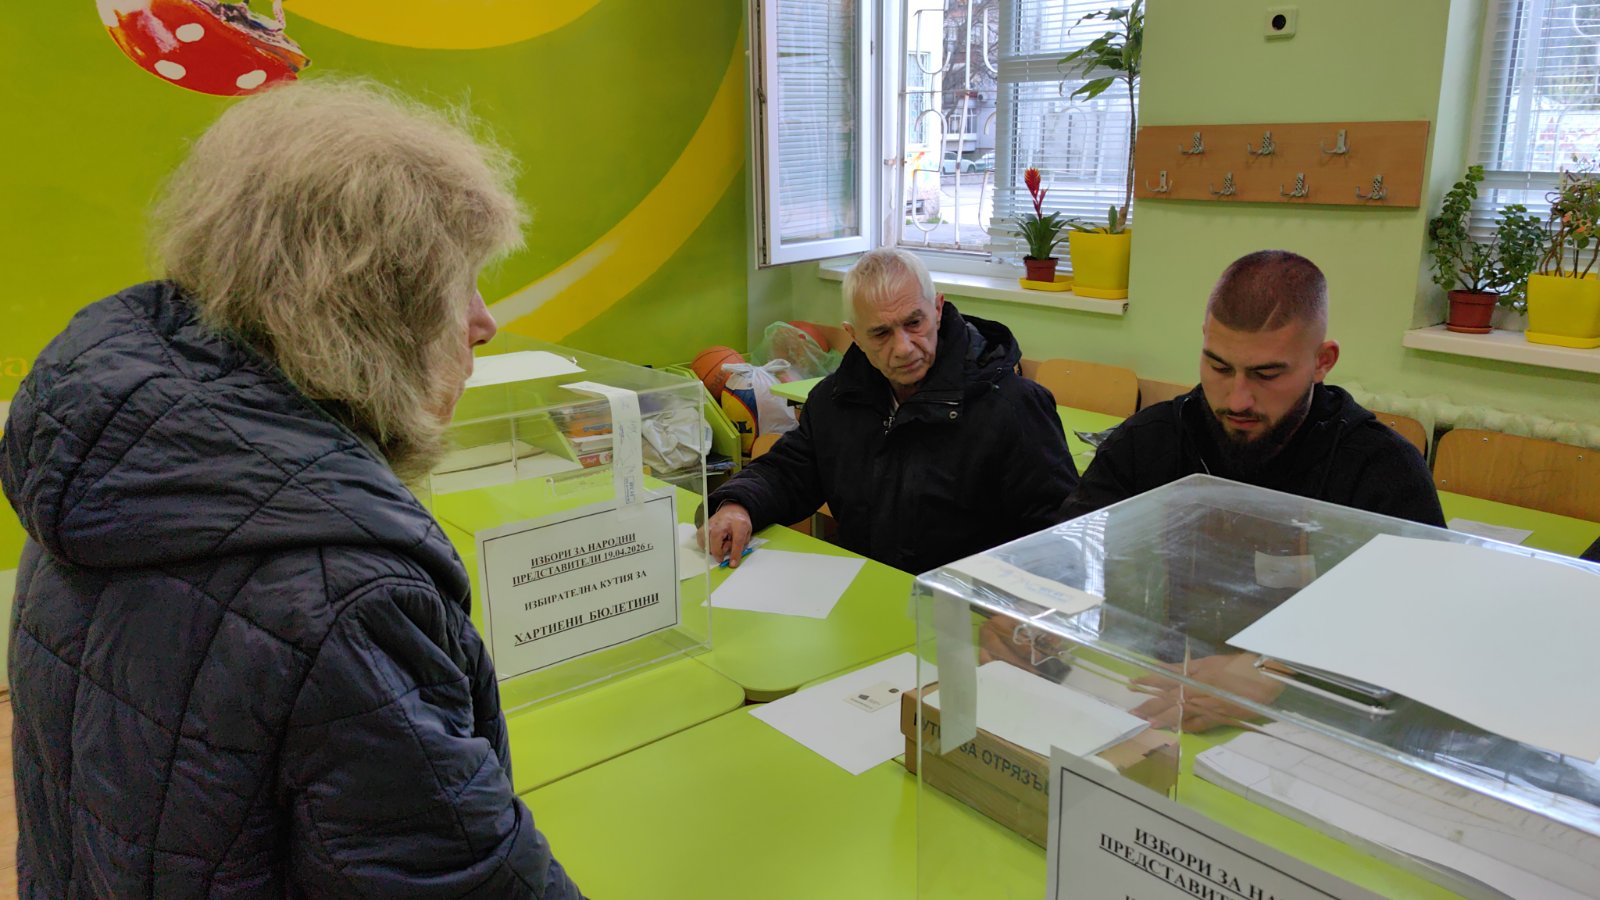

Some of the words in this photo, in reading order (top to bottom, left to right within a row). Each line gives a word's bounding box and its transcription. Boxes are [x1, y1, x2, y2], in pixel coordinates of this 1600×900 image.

[512, 553, 602, 585] ПРЕДСТАВИТЕЛИ
[604, 543, 646, 561] 19.04.2026
[530, 548, 572, 567] ИЗБОРИ
[574, 546, 586, 556] ЗА
[588, 532, 636, 552] НАРОДНИ
[524, 583, 598, 612] ИЗБИРАТЕЛНА
[600, 572, 633, 589] КУТИЯ
[635, 570, 647, 579] ЗА
[514, 614, 583, 645] ХАРТИЕНИ
[589, 592, 660, 622] БЮЛЕТИНИ
[1135, 827, 1212, 877] ИЗБОРИ
[1219, 868, 1241, 892] ЗА
